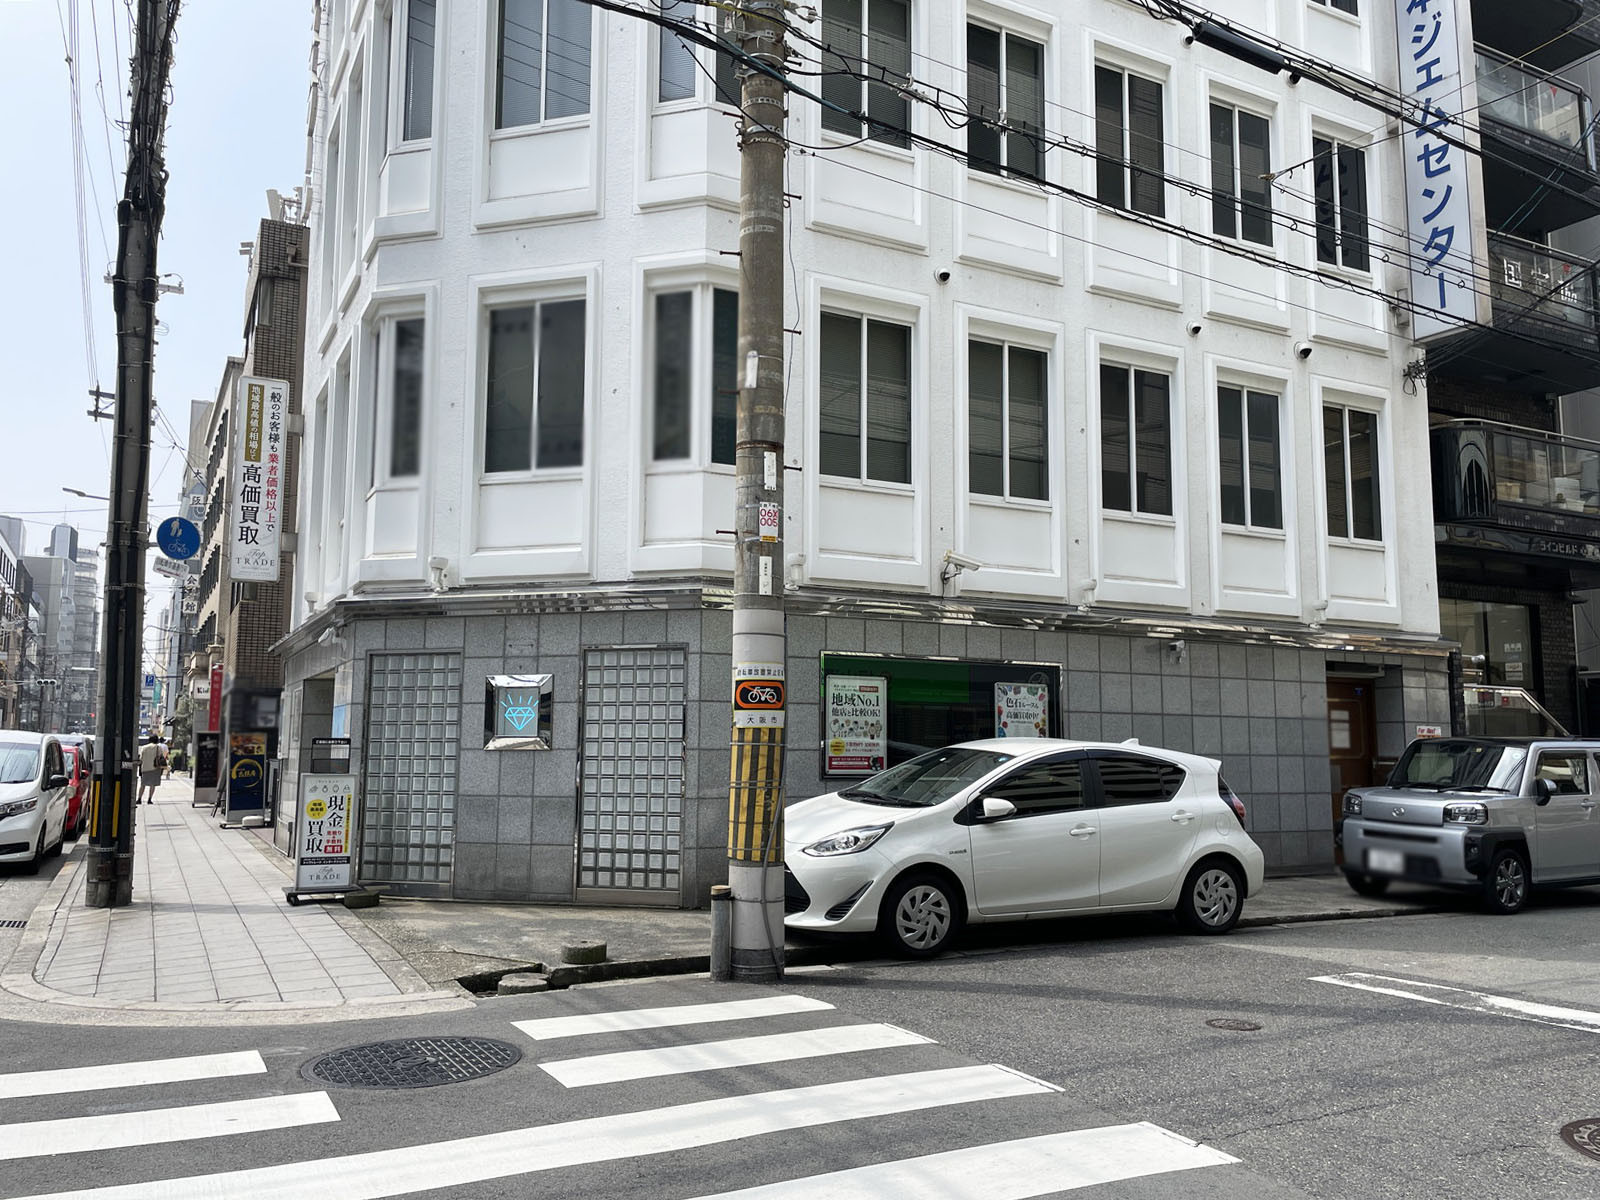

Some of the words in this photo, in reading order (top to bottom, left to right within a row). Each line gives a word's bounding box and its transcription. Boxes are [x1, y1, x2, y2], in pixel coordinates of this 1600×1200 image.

[238, 464, 262, 545] 高価買取
[236, 557, 276, 567] TRADE
[737, 668, 784, 677] 自転車放置禁止区
[832, 692, 880, 707] 地域No.1
[747, 716, 778, 724] 大阪市
[327, 795, 344, 828] 現金
[306, 820, 324, 854] 買取
[308, 873, 341, 881] TRADE
